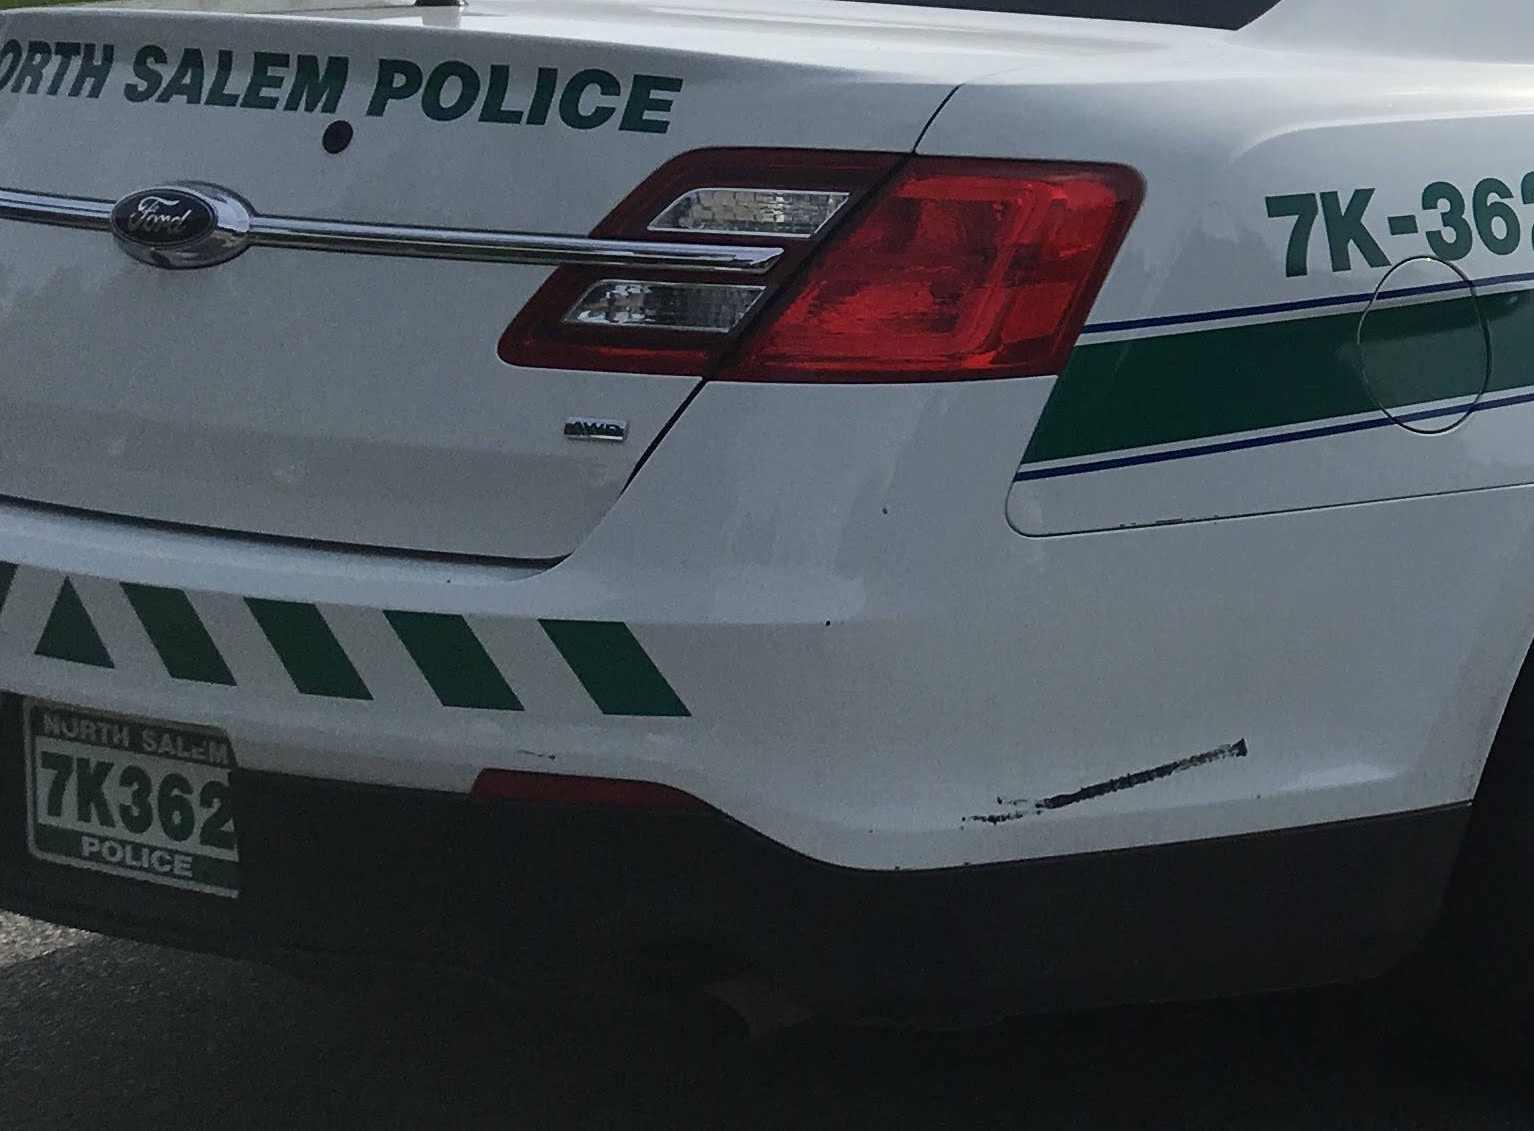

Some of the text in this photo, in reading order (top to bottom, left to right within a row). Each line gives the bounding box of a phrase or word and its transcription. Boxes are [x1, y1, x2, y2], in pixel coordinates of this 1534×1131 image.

[124, 44, 350, 114] SALEM
[367, 58, 683, 134] POLICE
[129, 196, 192, 232] Ford
[43, 713, 130, 747] NORTH
[41, 750, 237, 851] 7K362
[81, 835, 193, 878] POLICE
